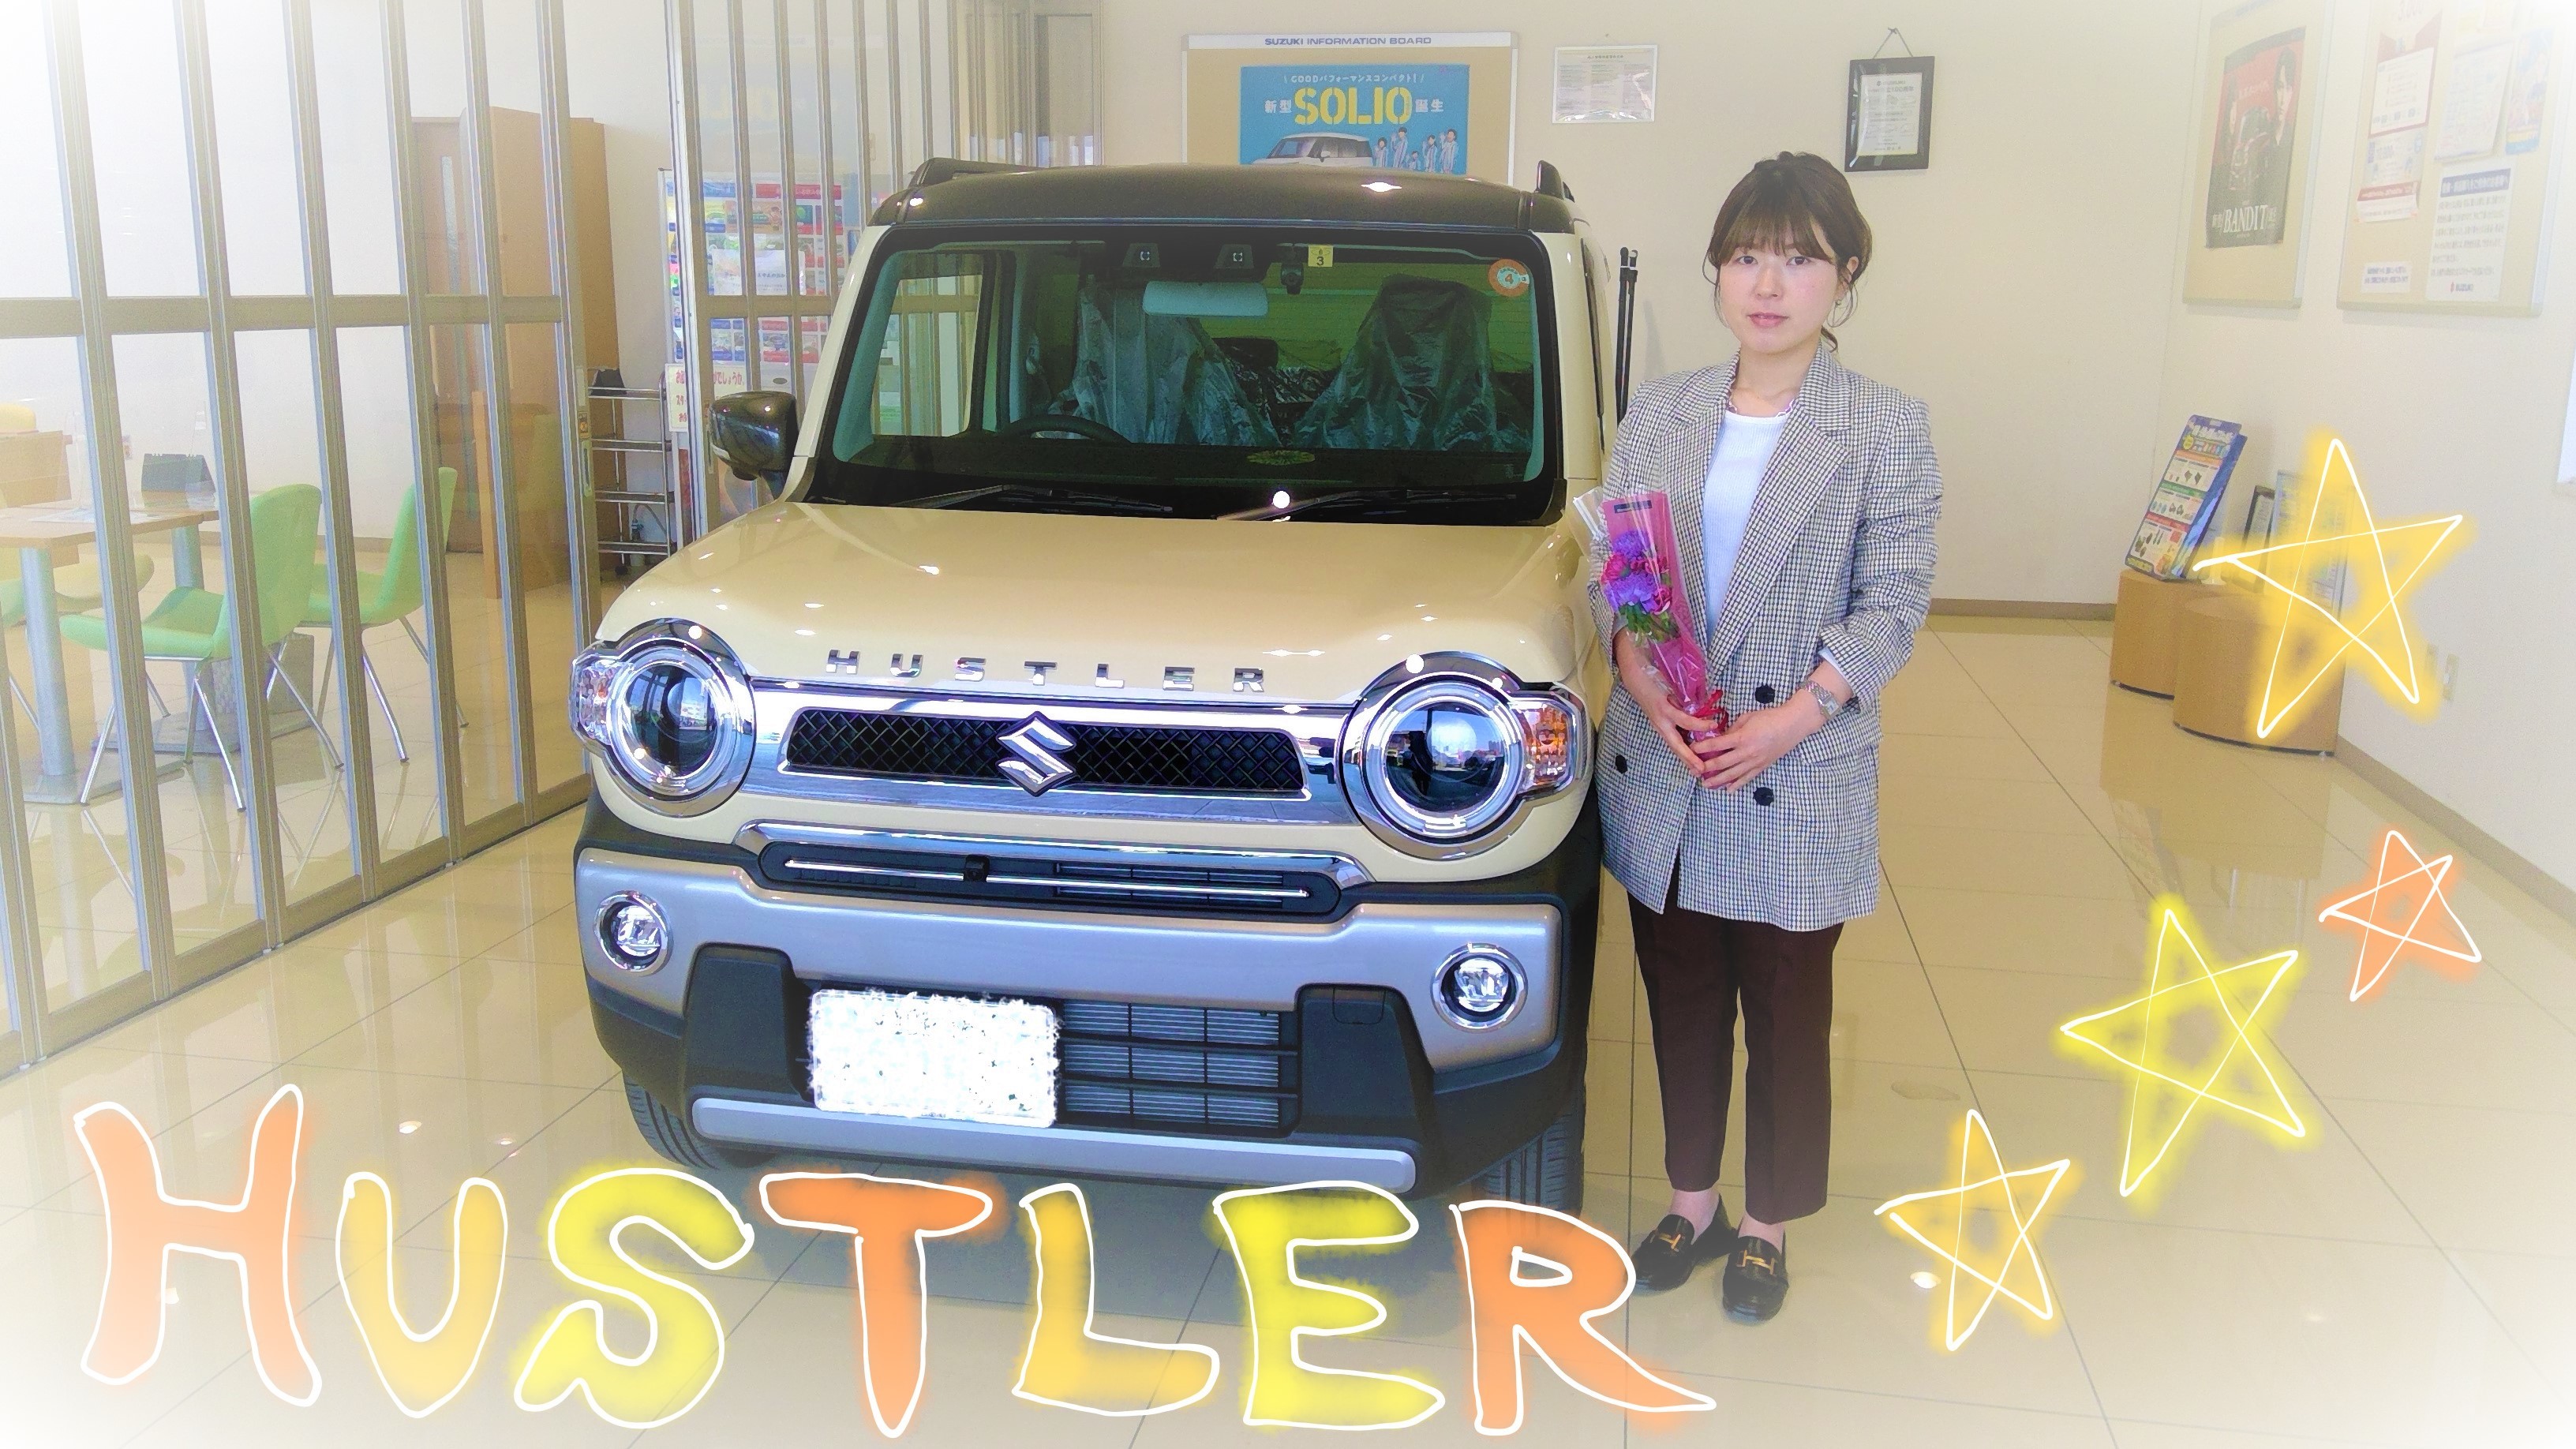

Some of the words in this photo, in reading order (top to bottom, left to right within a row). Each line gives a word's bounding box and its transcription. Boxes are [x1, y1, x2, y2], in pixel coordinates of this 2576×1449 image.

[1264, 37, 1304, 46] SUZUKI
[1264, 99, 1293, 114] 新型
[1294, 86, 1413, 125] SOLIO
[2222, 204, 2269, 233] BANDIT
[1316, 256, 1324, 266] 3
[1504, 273, 1515, 285] 4
[826, 649, 1265, 693] HUSTLER
